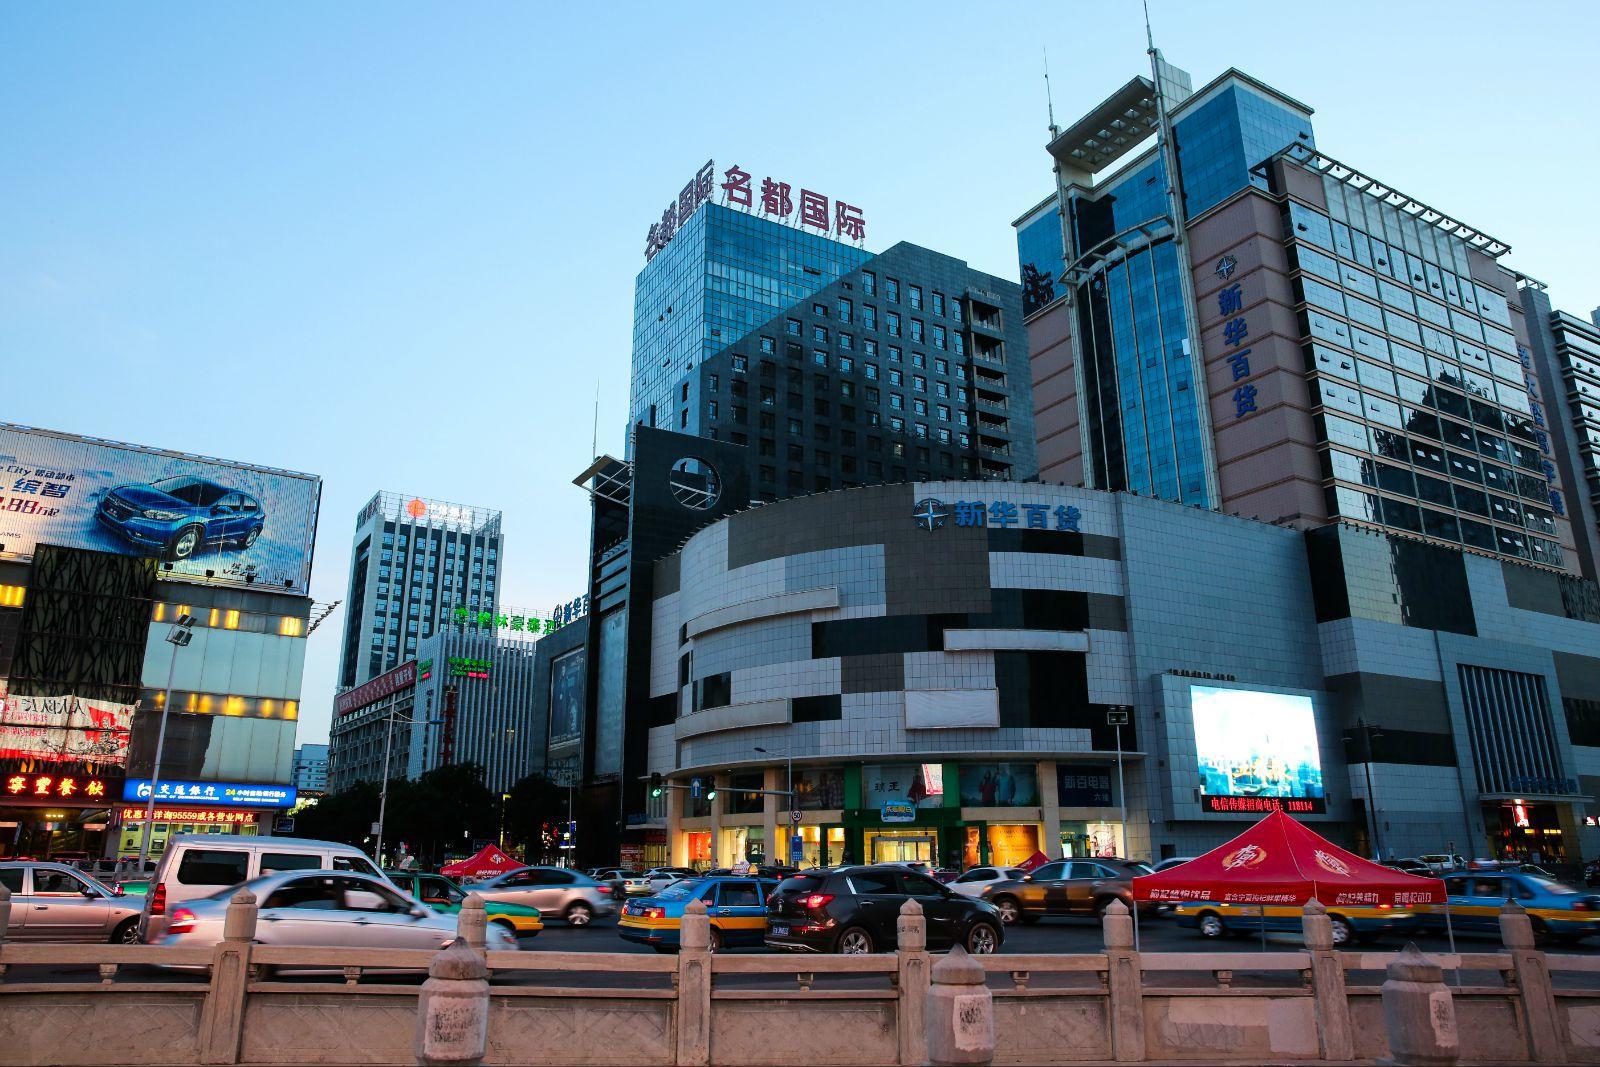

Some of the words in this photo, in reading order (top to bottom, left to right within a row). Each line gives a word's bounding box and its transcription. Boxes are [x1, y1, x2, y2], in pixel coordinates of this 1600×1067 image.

[644, 158, 714, 262] 名都国际
[721, 164, 866, 241] 名都国际
[1218, 282, 1258, 418] 新华百货
[6, 465, 31, 477] City
[34, 469, 75, 482] 动都市
[12, 477, 71, 499] 缤智
[954, 500, 1082, 532] 新华百货
